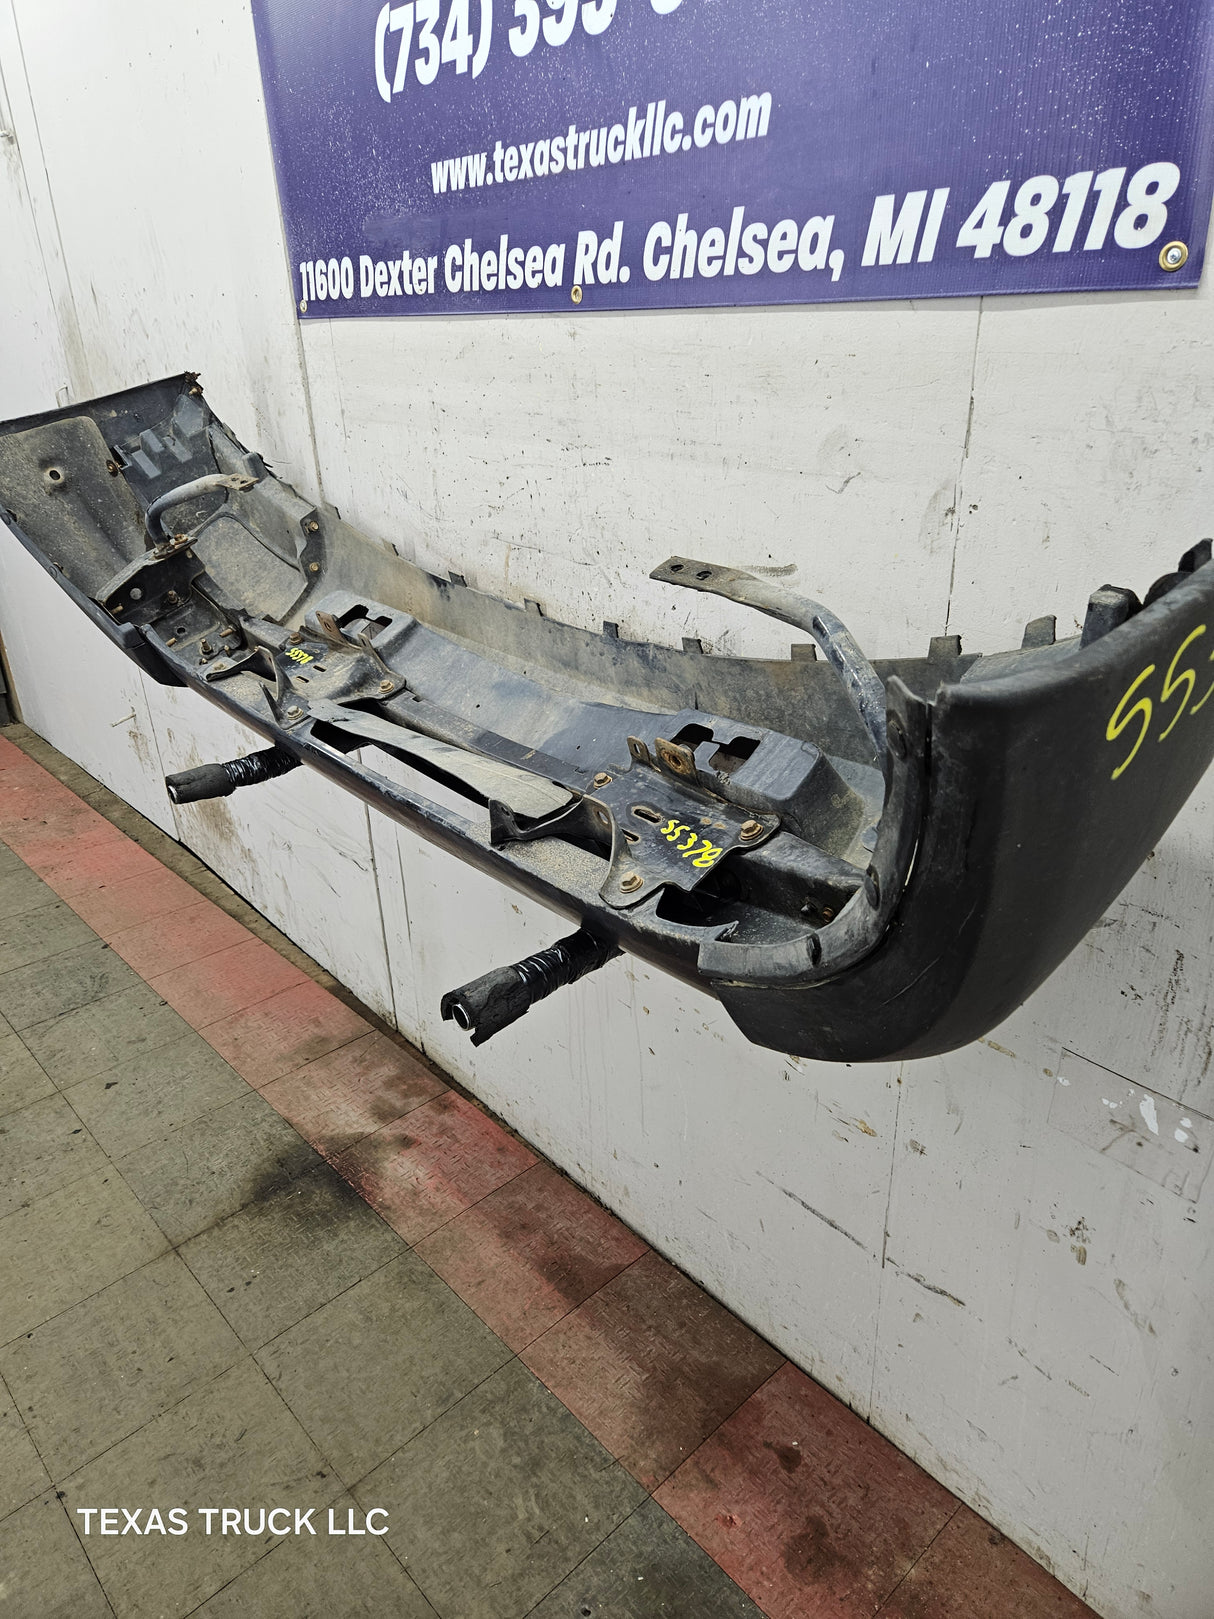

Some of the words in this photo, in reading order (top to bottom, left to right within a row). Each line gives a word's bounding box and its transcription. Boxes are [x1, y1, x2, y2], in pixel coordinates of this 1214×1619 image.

[375, 0, 493, 103] (734)
[431, 92, 773, 194] www.texastruckllc.com
[299, 256, 354, 301] 11600
[359, 254, 437, 298] Dexter
[444, 233, 566, 294] Chelsea
[573, 220, 631, 286] Rd.
[643, 205, 845, 282] Chelsea,
[860, 187, 951, 267] MI
[955, 161, 1181, 259] 48118
